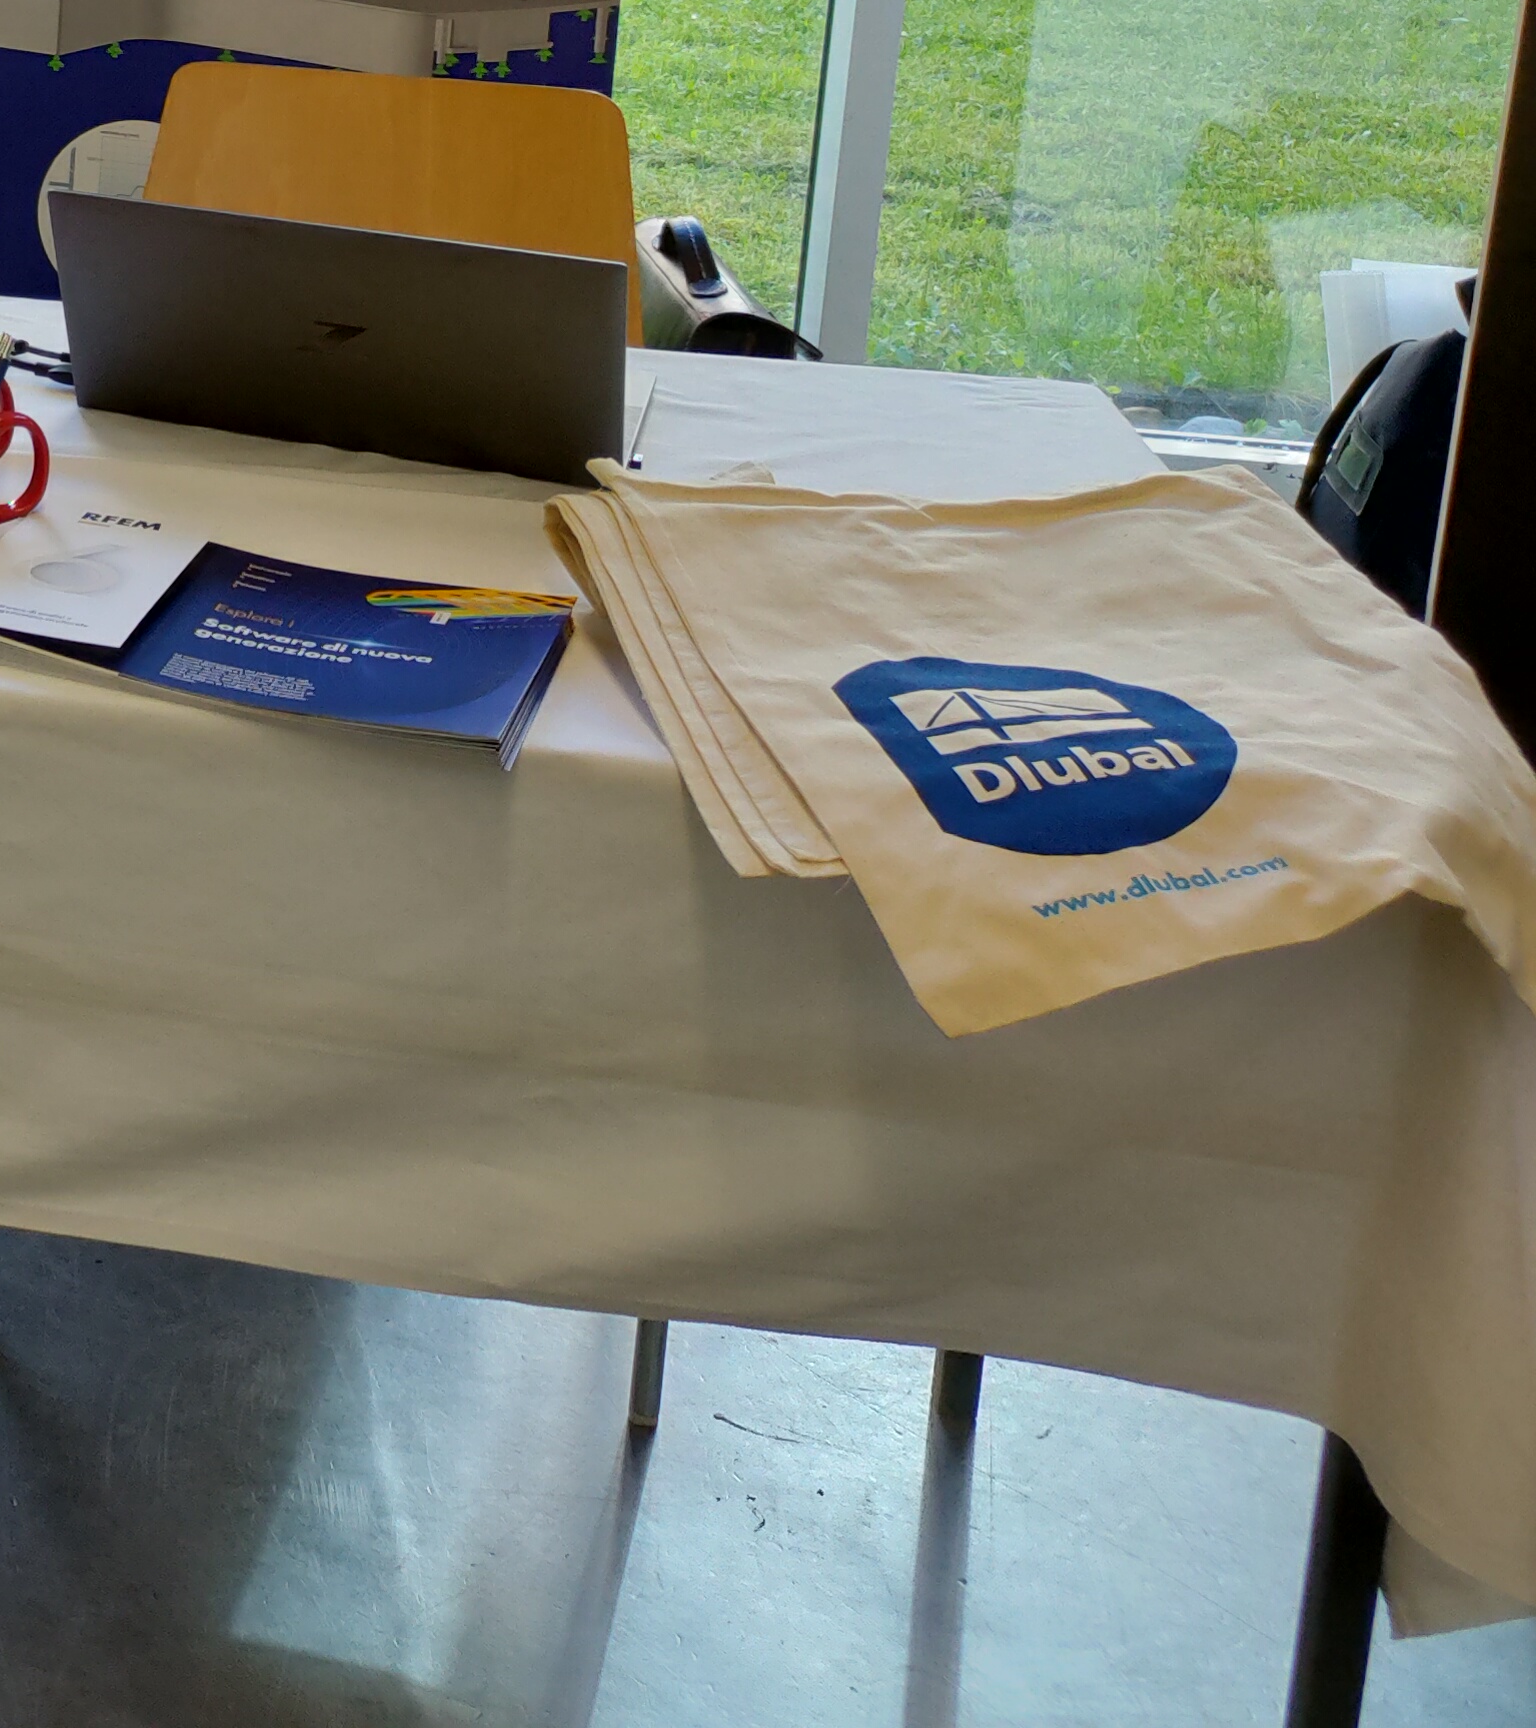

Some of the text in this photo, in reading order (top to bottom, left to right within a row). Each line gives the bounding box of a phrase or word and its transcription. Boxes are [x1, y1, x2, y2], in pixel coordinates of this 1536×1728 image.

[81, 512, 162, 531] RFEM
[194, 628, 353, 664] generazione
[202, 618, 433, 664] Software di nuova
[953, 738, 1196, 805] Dlubal
[1031, 855, 1290, 920] www.dlubal.com
